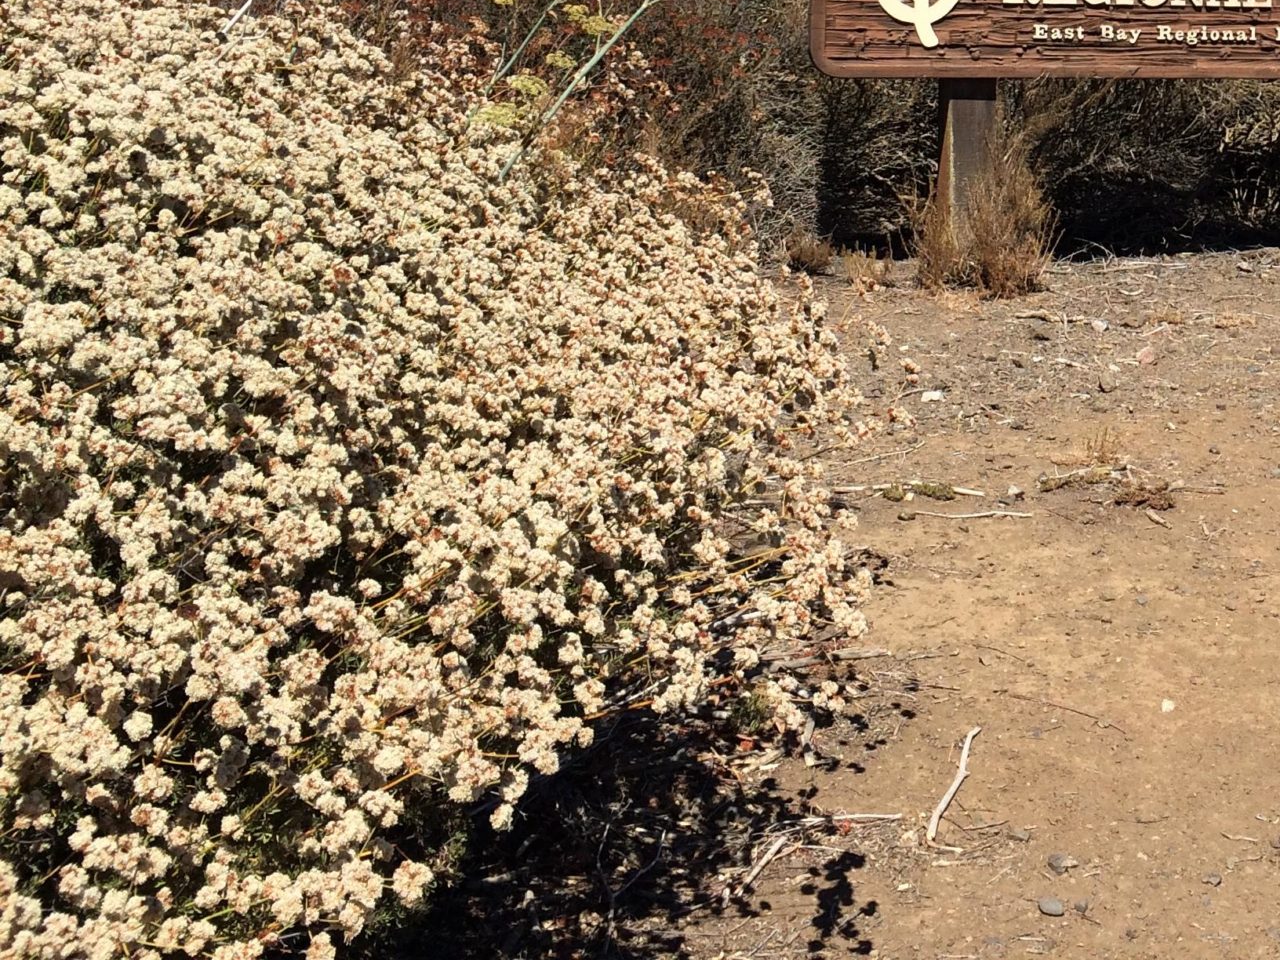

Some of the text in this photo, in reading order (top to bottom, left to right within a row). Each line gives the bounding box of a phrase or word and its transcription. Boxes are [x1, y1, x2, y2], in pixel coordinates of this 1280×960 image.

[1032, 24, 1085, 40] East
[1099, 24, 1142, 45] Bay
[1156, 25, 1258, 45] Regional
